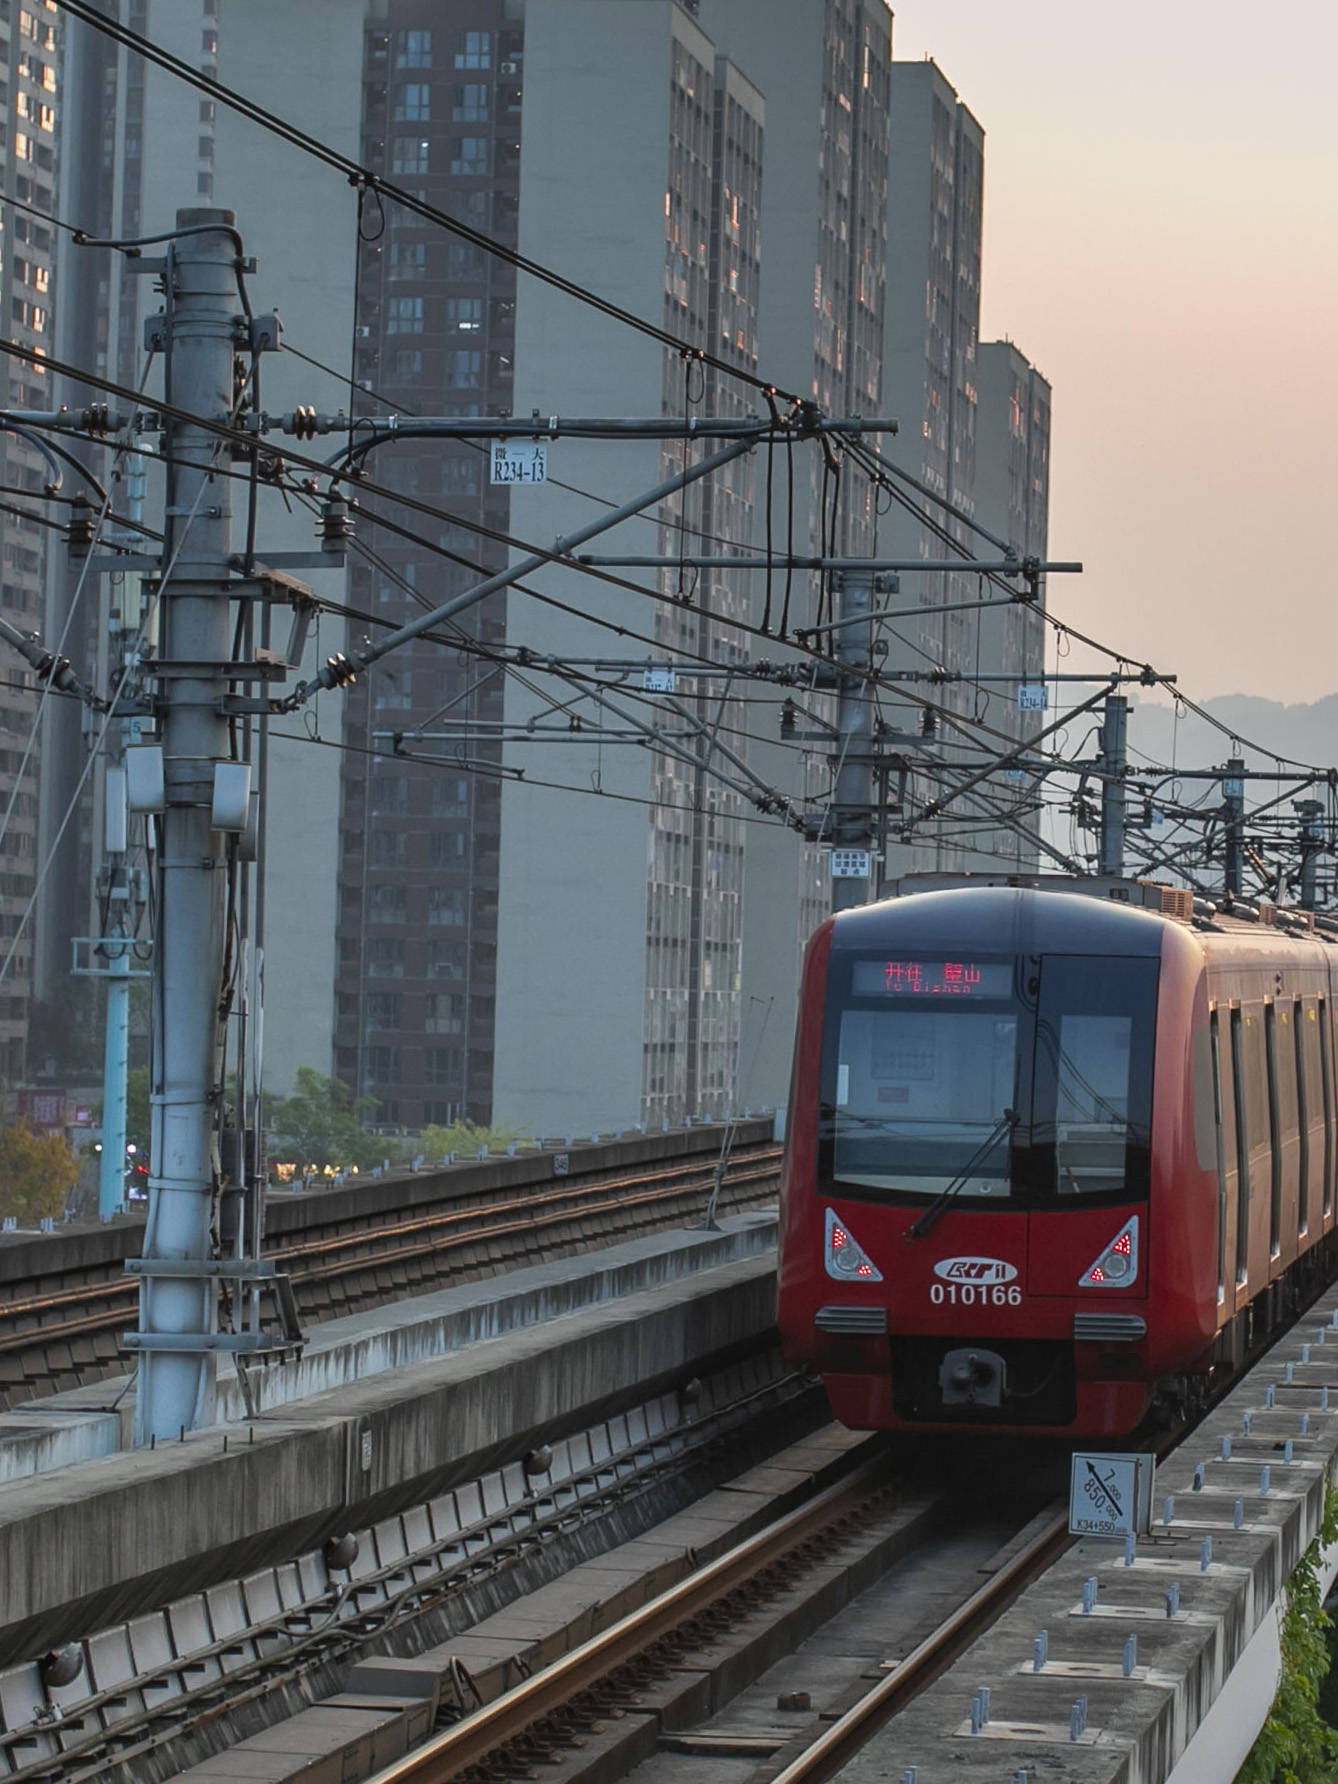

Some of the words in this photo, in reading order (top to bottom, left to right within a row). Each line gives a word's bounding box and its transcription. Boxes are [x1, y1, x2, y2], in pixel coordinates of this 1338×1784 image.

[494, 461, 545, 482] R234-13
[884, 962, 923, 983] 开往
[944, 963, 981, 984] 璧山
[912, 981, 972, 994] Bishan
[930, 1284, 1022, 1306] 010166
